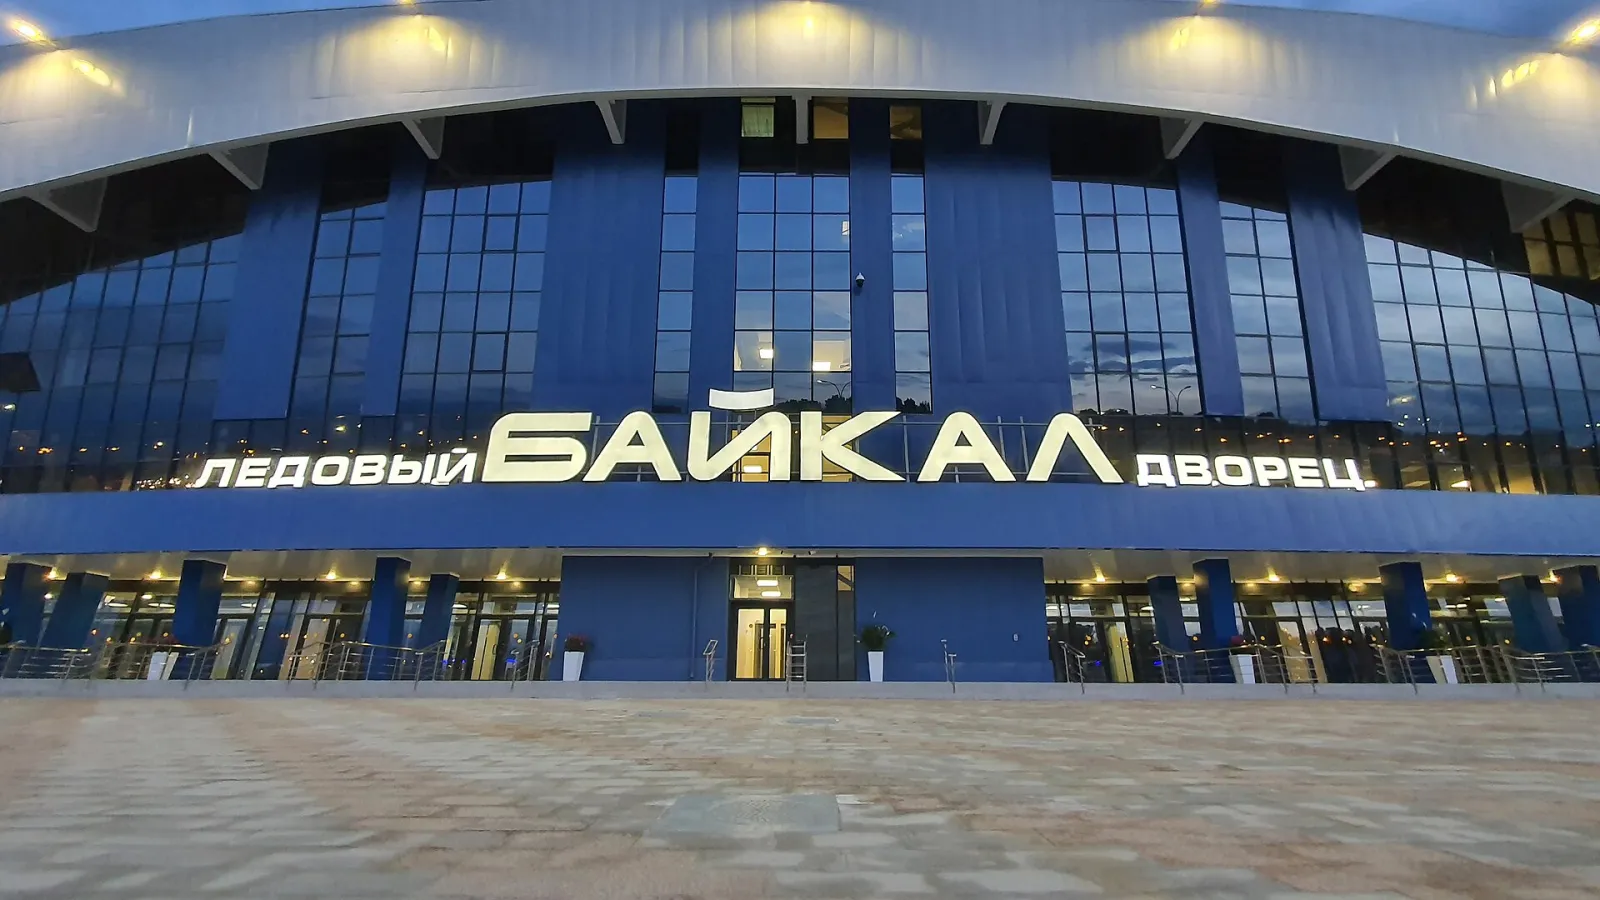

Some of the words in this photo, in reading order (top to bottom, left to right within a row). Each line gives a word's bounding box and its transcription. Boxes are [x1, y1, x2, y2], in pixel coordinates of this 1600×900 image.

[195, 447, 477, 488] ЛЕДОВЫЙ
[481, 388, 1124, 483] БАЙКАЛ
[1136, 453, 1367, 491] ДВОРЕЦ
